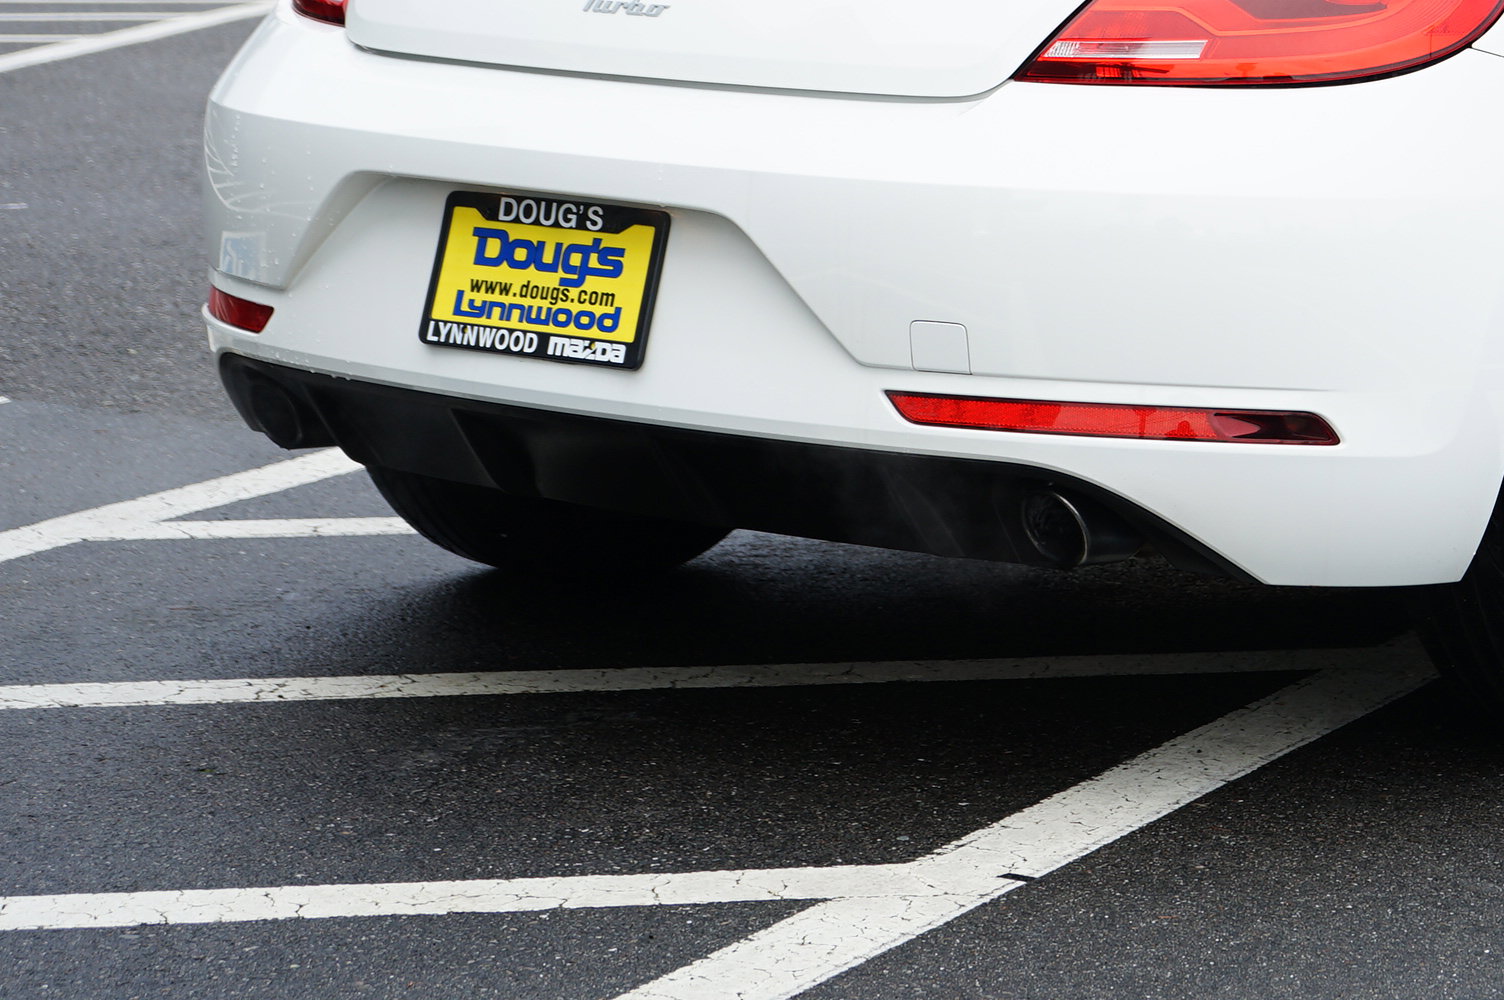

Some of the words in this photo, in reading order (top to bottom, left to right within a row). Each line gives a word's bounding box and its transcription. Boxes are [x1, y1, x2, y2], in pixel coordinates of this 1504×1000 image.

[498, 197, 604, 231] DOUG'S
[472, 226, 626, 288] Doug's
[470, 278, 616, 308] www.dougs.com
[453, 290, 622, 333] Lynnwood
[426, 320, 538, 354] LYNNWOOD
